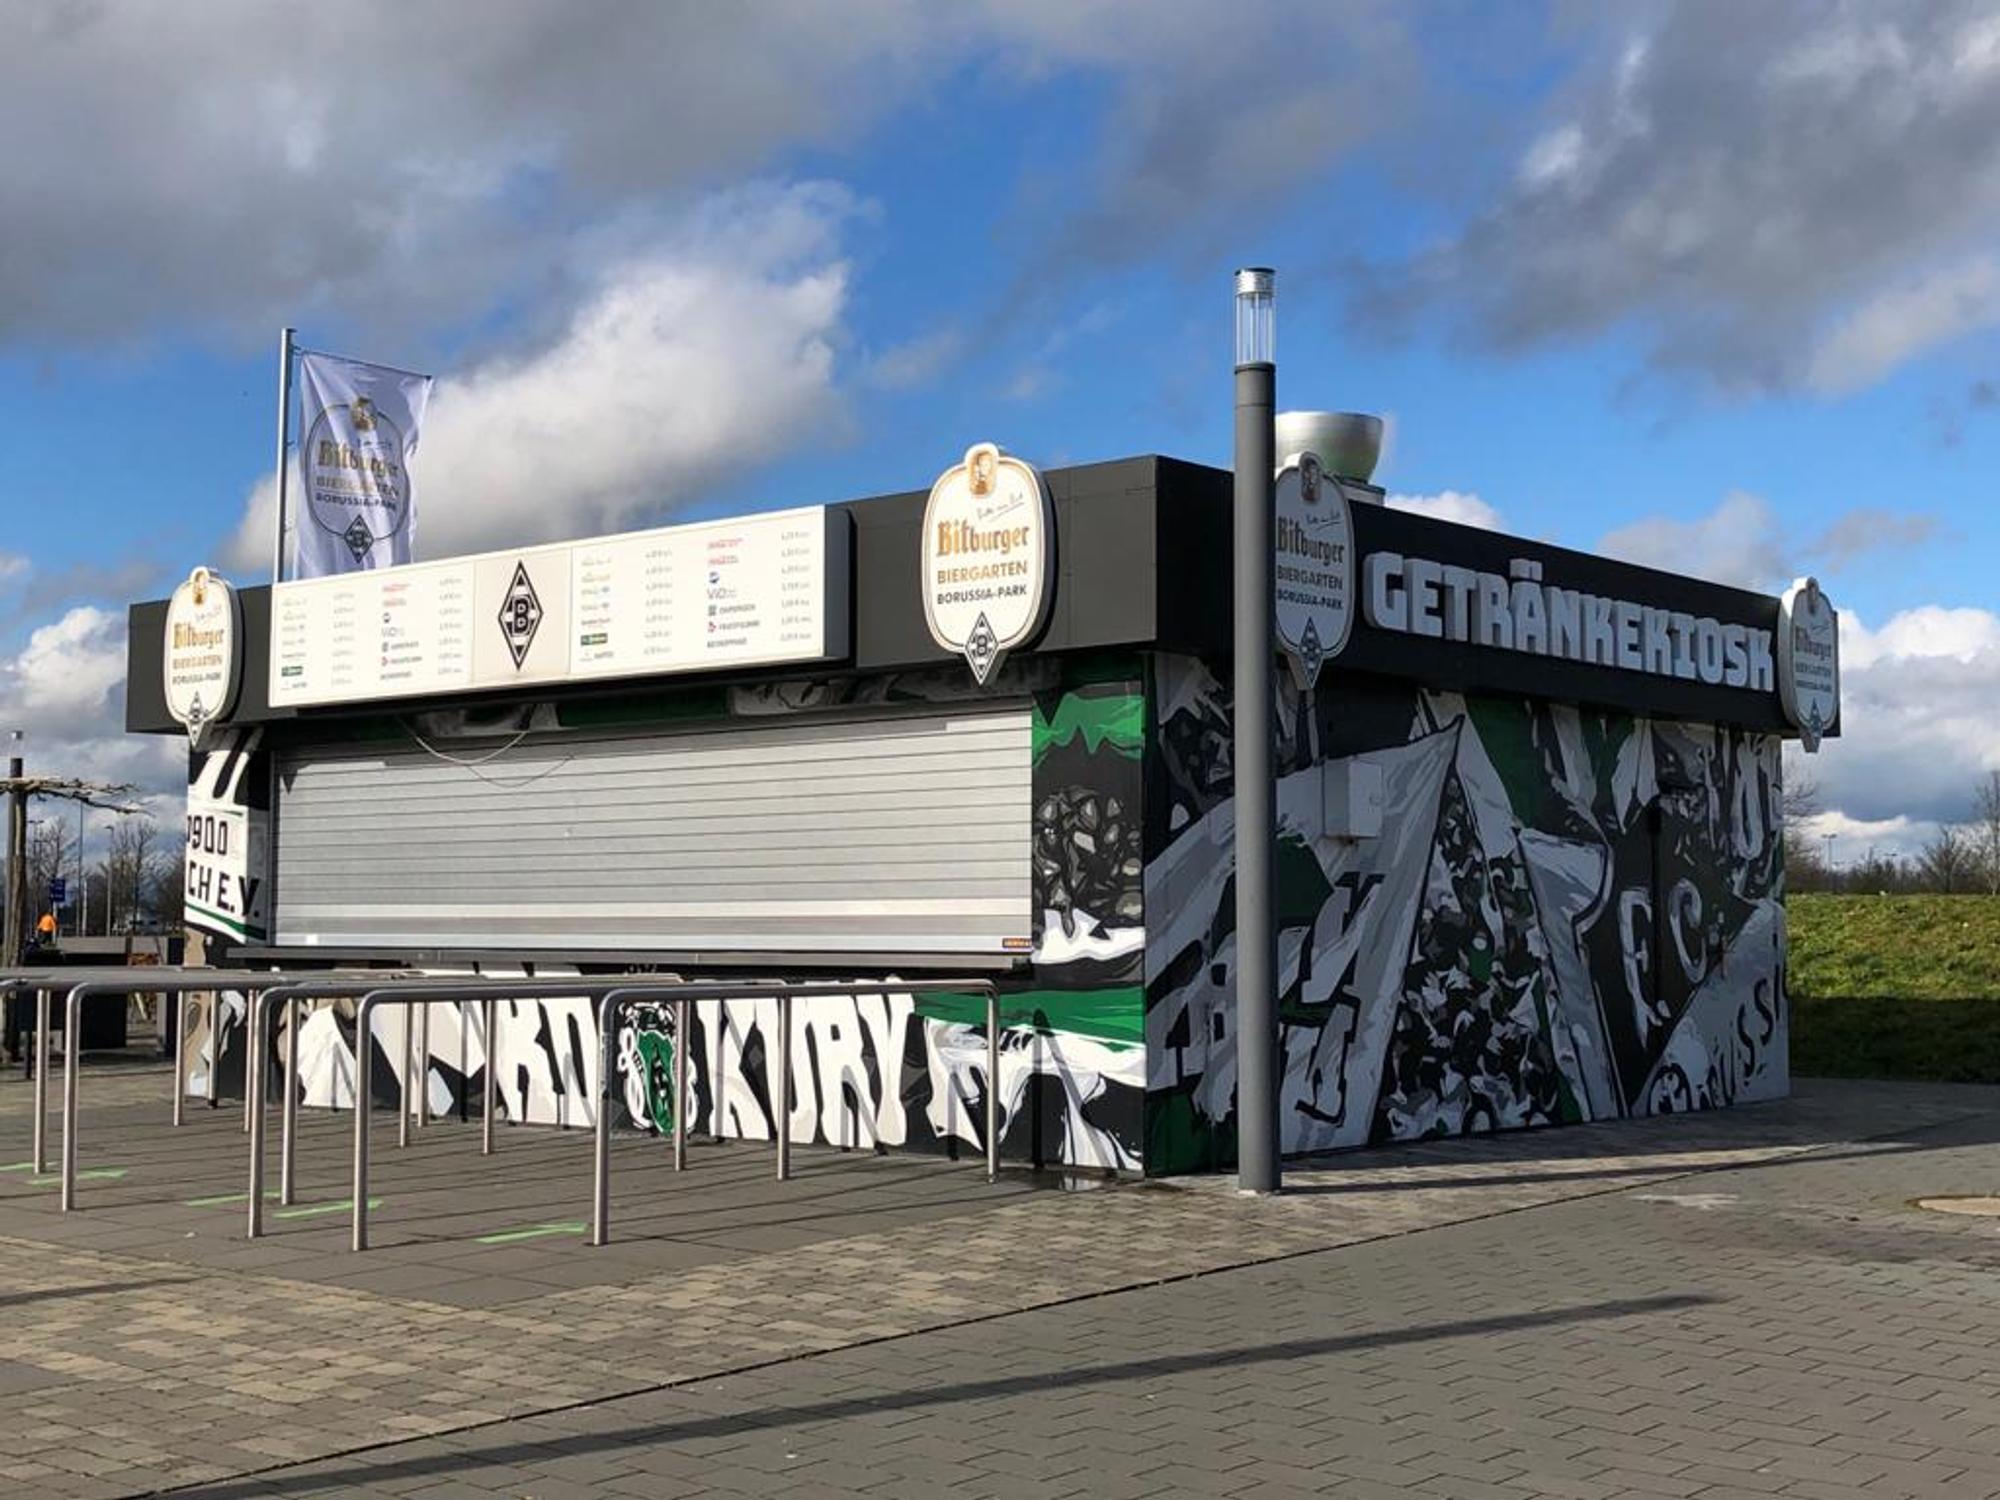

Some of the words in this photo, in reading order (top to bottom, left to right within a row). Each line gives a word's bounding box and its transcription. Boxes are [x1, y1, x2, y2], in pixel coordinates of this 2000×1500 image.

[936, 518, 1030, 558] Bitburger
[1277, 516, 1345, 566] Bitburger
[937, 560, 1028, 585] BIERGARTEN
[1277, 564, 1343, 591] BIERGARTEN
[936, 584, 1028, 605] BORUSSIA-PARK
[1363, 550, 1775, 692] GETRÄNKEKIOSK
